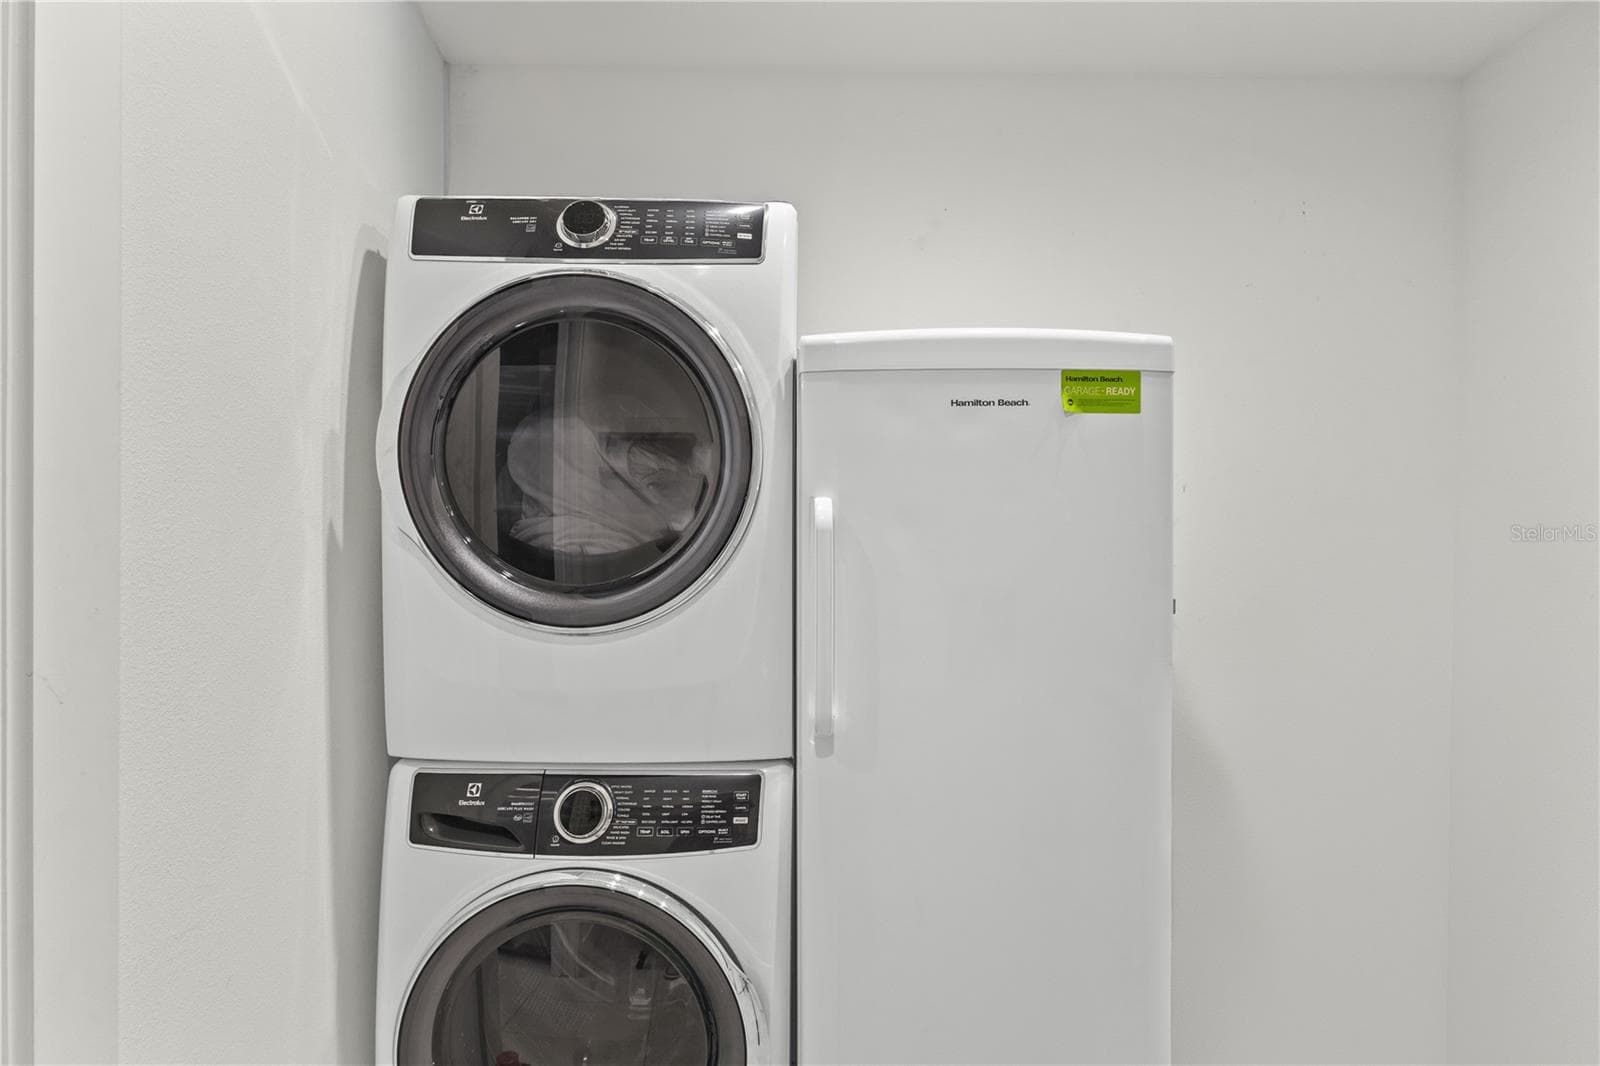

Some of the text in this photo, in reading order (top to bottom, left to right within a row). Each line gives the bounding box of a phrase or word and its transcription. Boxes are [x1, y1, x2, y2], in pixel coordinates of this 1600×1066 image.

[1065, 375, 1098, 383] Hamilton
[1064, 386, 1136, 396] GARAGE READY
[950, 399, 995, 407] Hamilton
